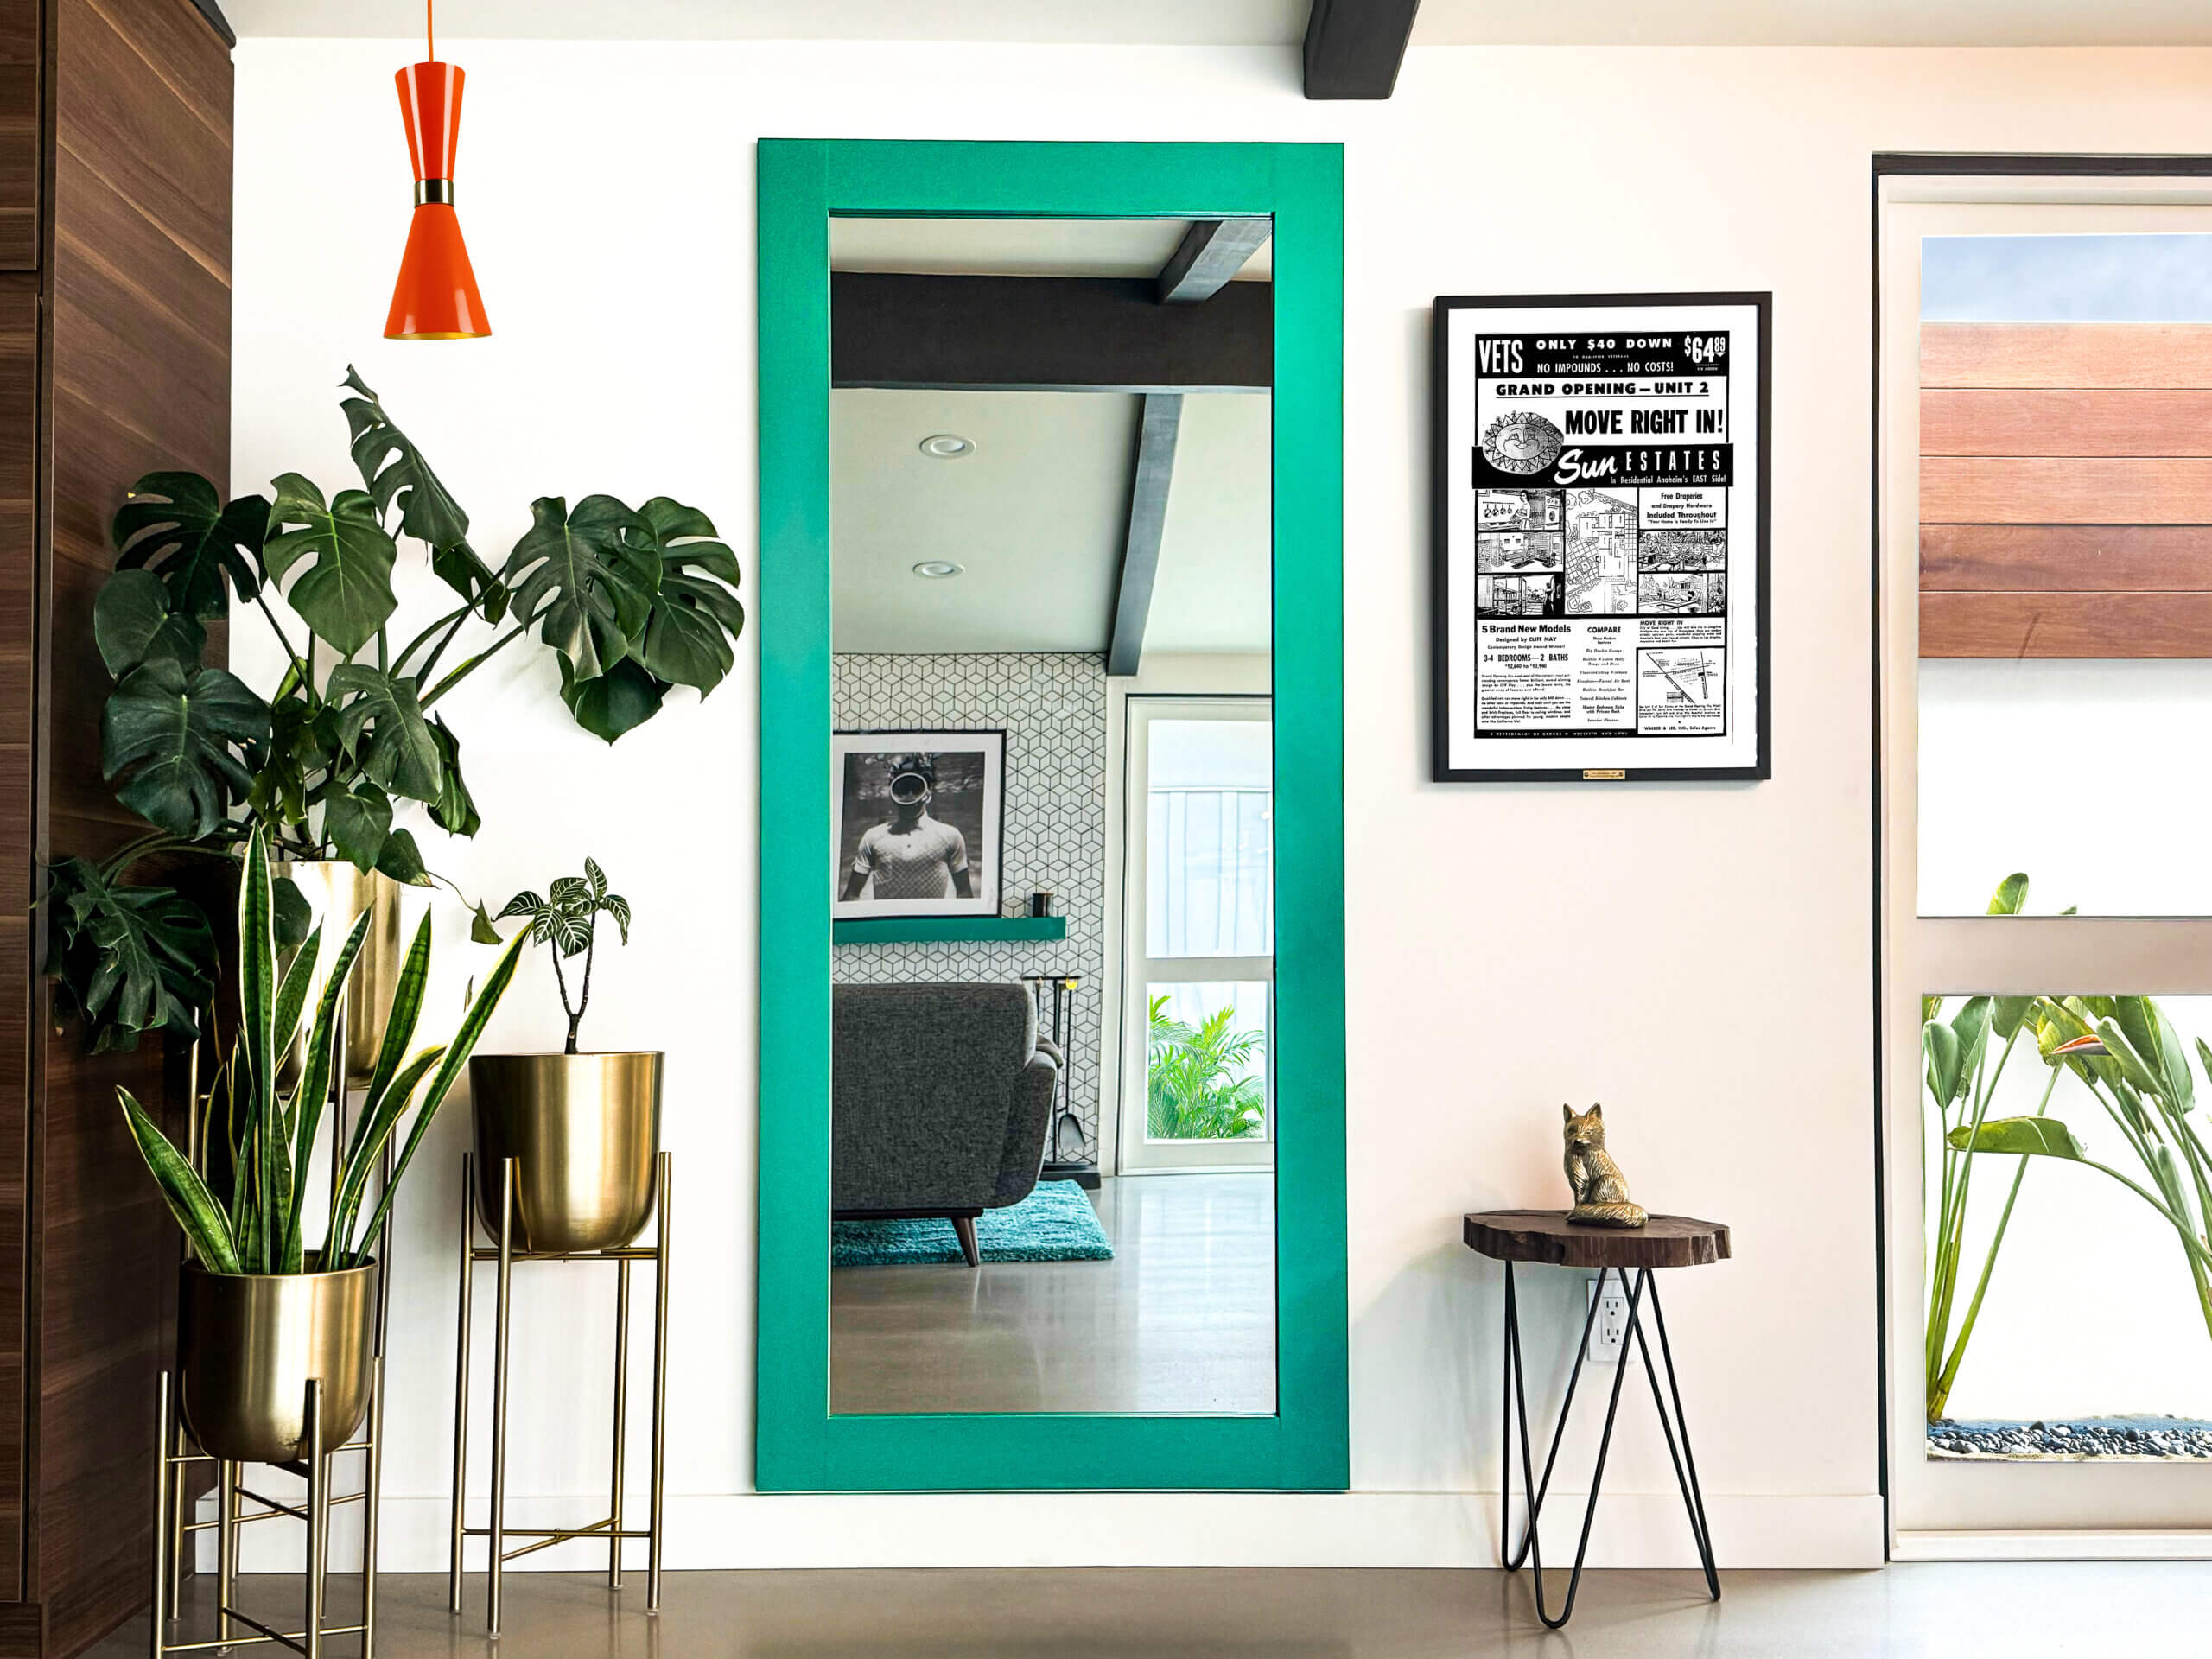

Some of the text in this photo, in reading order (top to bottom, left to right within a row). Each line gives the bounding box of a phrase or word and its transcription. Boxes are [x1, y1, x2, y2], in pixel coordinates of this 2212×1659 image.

[1536, 339, 1671, 350] ONLY $40 DOWN
[1479, 340, 1522, 373] VETS
[1537, 364, 1549, 373] NO
[1555, 363, 1601, 372] IMPOUNDS
[1628, 362, 1639, 372] NO
[1645, 362, 1673, 372] COSTS!
[1496, 384, 1554, 396] GRAND
[1562, 383, 1636, 395] OPENING
[1655, 382, 1693, 394] UNIT
[1700, 382, 1708, 393] 2
[1566, 409, 1723, 435] MOVE RIGHT IN!
[1554, 448, 1719, 484] Sun ESTATES
[1676, 493, 1702, 501] Draperies
[1677, 512, 1716, 520] Throughout
[1490, 625, 1516, 633] Brand
